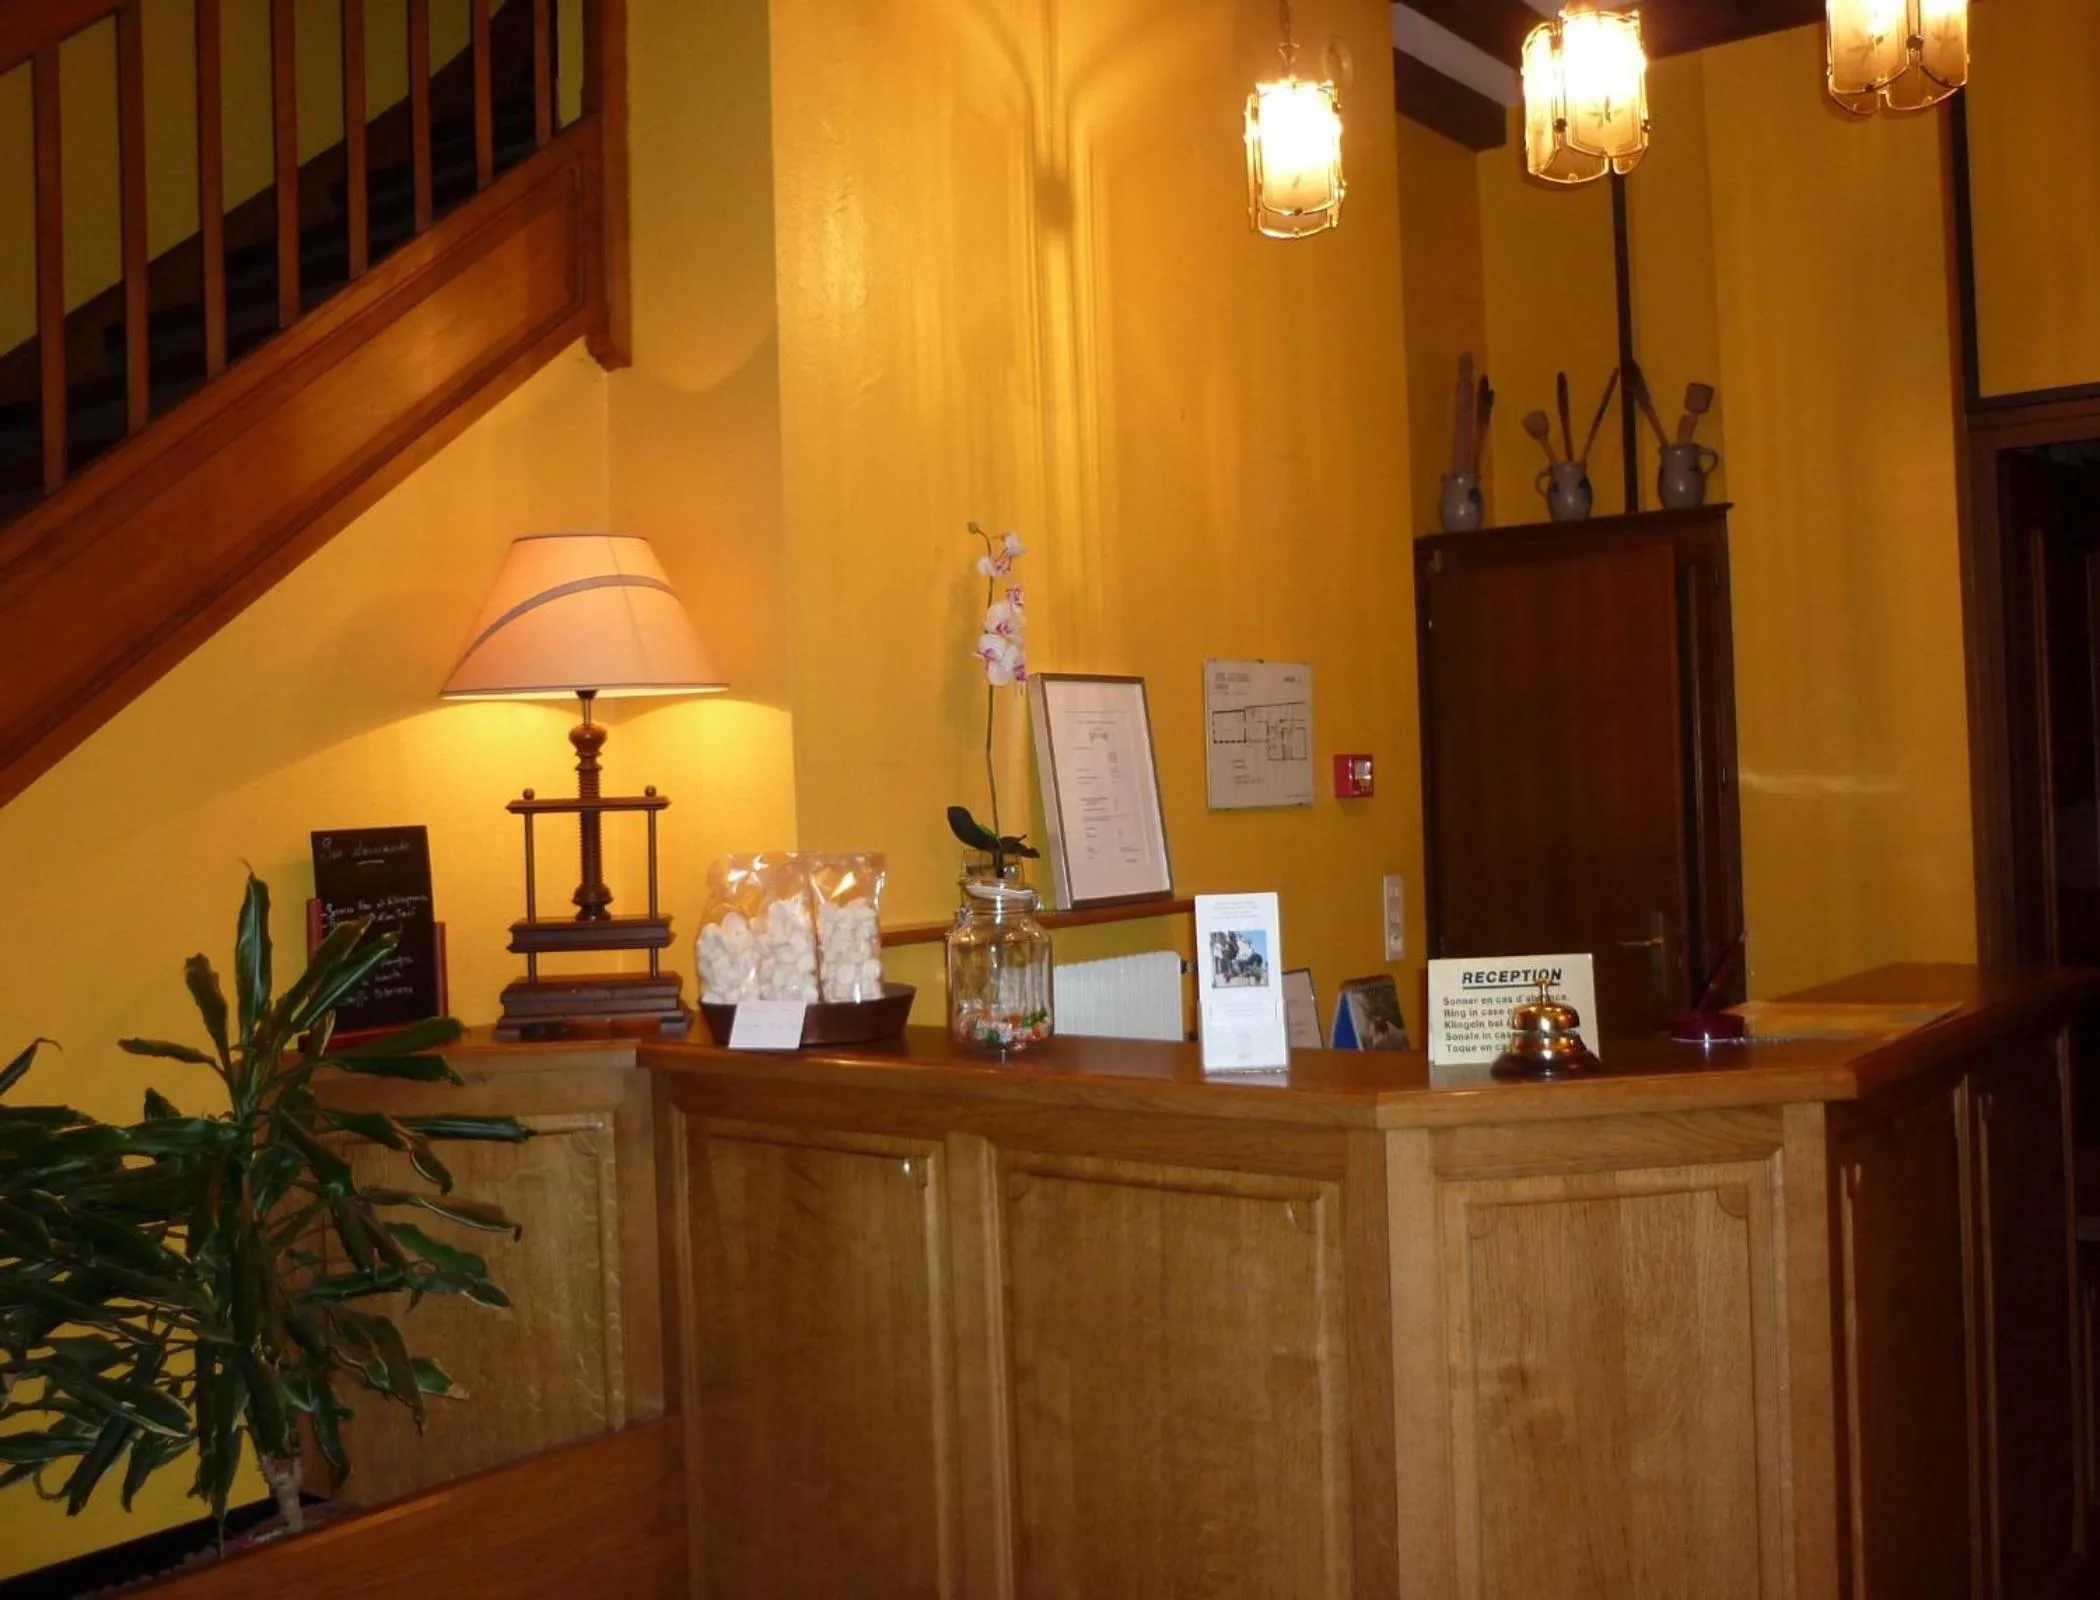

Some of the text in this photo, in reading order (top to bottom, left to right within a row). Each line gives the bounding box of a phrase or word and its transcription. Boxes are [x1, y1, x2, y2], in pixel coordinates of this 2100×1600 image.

[1462, 968, 1562, 985] RECEPTION
[1443, 996, 1478, 1006] Sonner
[1481, 996, 1493, 1004] en
[1496, 995, 1513, 1004] cas
[1444, 1008, 1467, 1018] Ring
[1469, 1008, 1478, 1017] in
[1481, 1008, 1505, 1016] case
[1444, 1019, 1485, 1030] Klingeln
[1487, 1018, 1504, 1028] bei
[1445, 1031, 1478, 1041] Sonate
[1481, 1031, 1492, 1040] in
[1446, 1043, 1477, 1053] Toque
[1481, 1044, 1492, 1052] en
